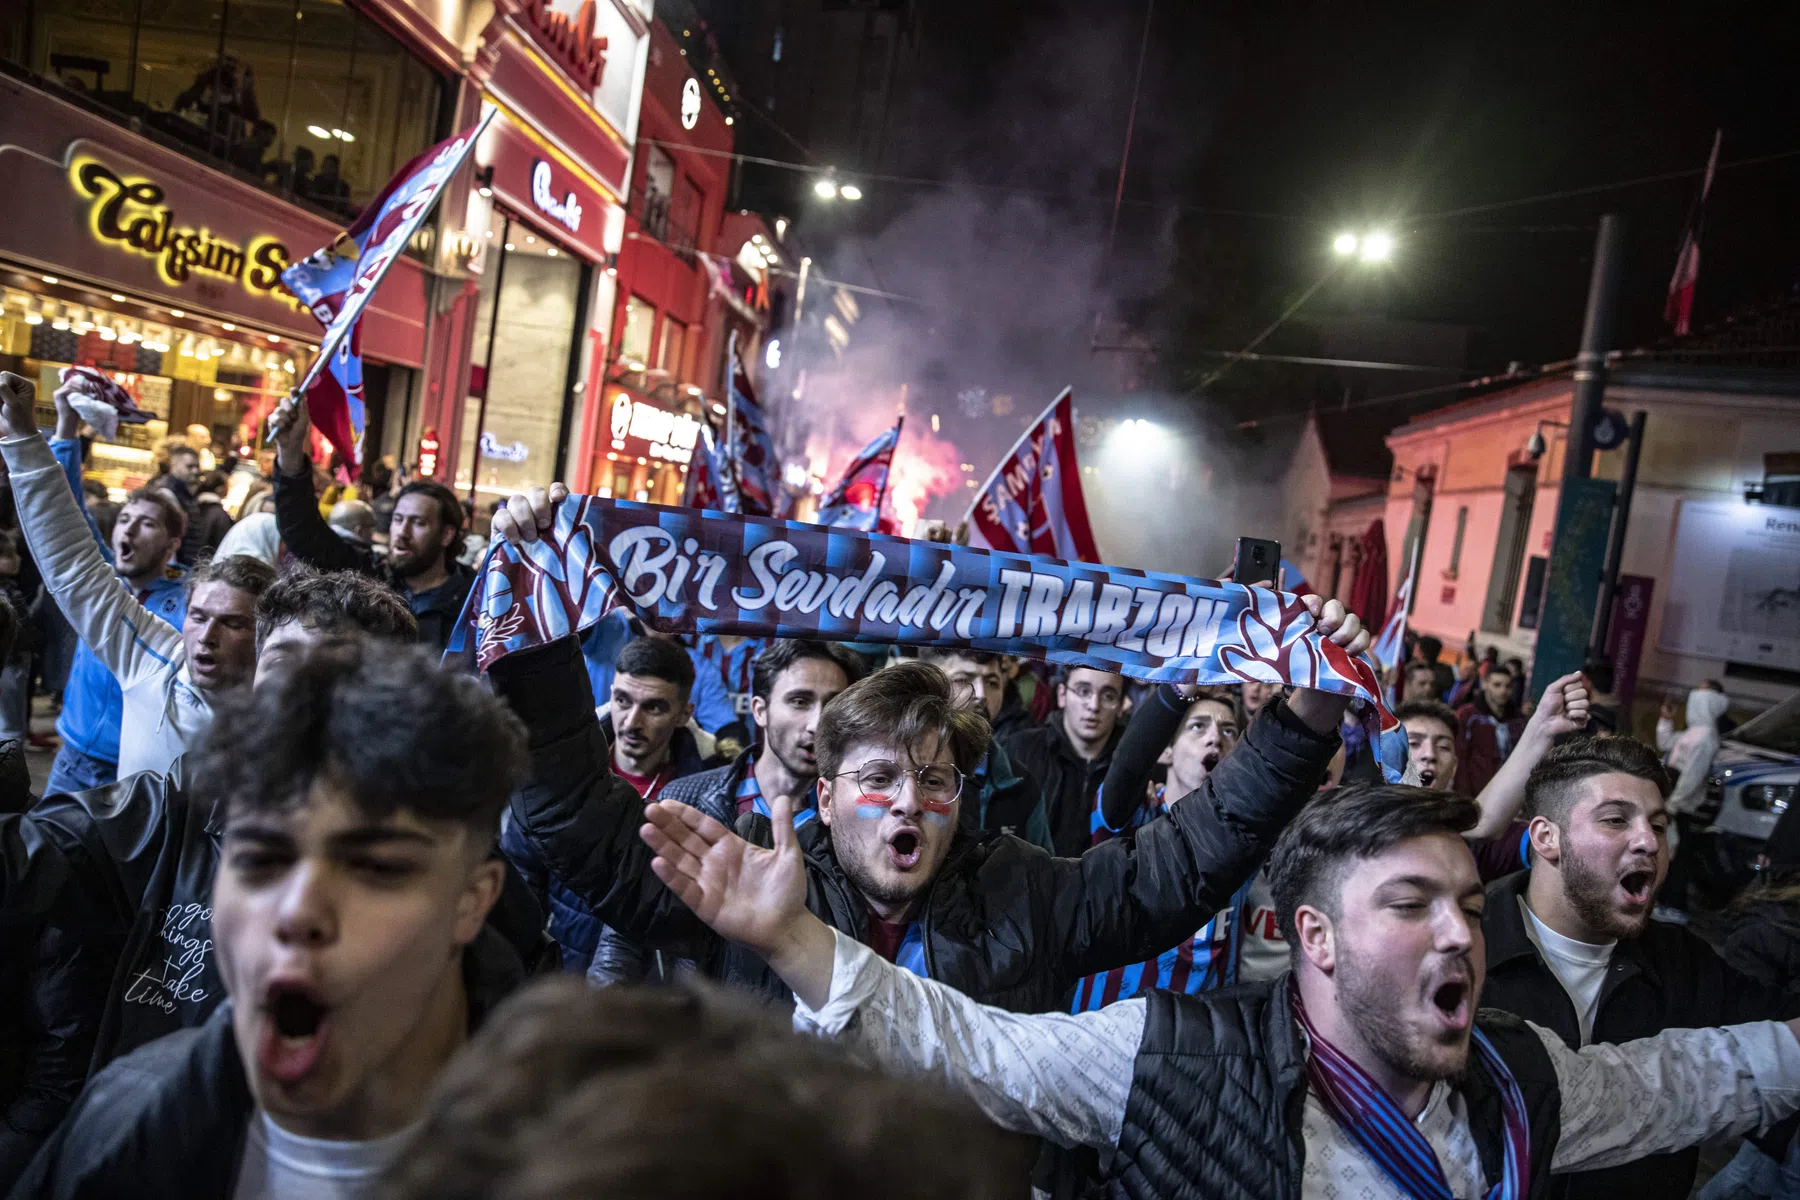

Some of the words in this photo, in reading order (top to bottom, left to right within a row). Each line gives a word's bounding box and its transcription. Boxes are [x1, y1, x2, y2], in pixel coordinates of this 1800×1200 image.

[75, 158, 245, 284] Taksim
[609, 525, 727, 611] Bir
[732, 540, 987, 638] Sevdadır
[998, 568, 1230, 659] TRABZON
[178, 903, 216, 930] go
[125, 968, 177, 1015] time
[163, 955, 209, 1003] take
